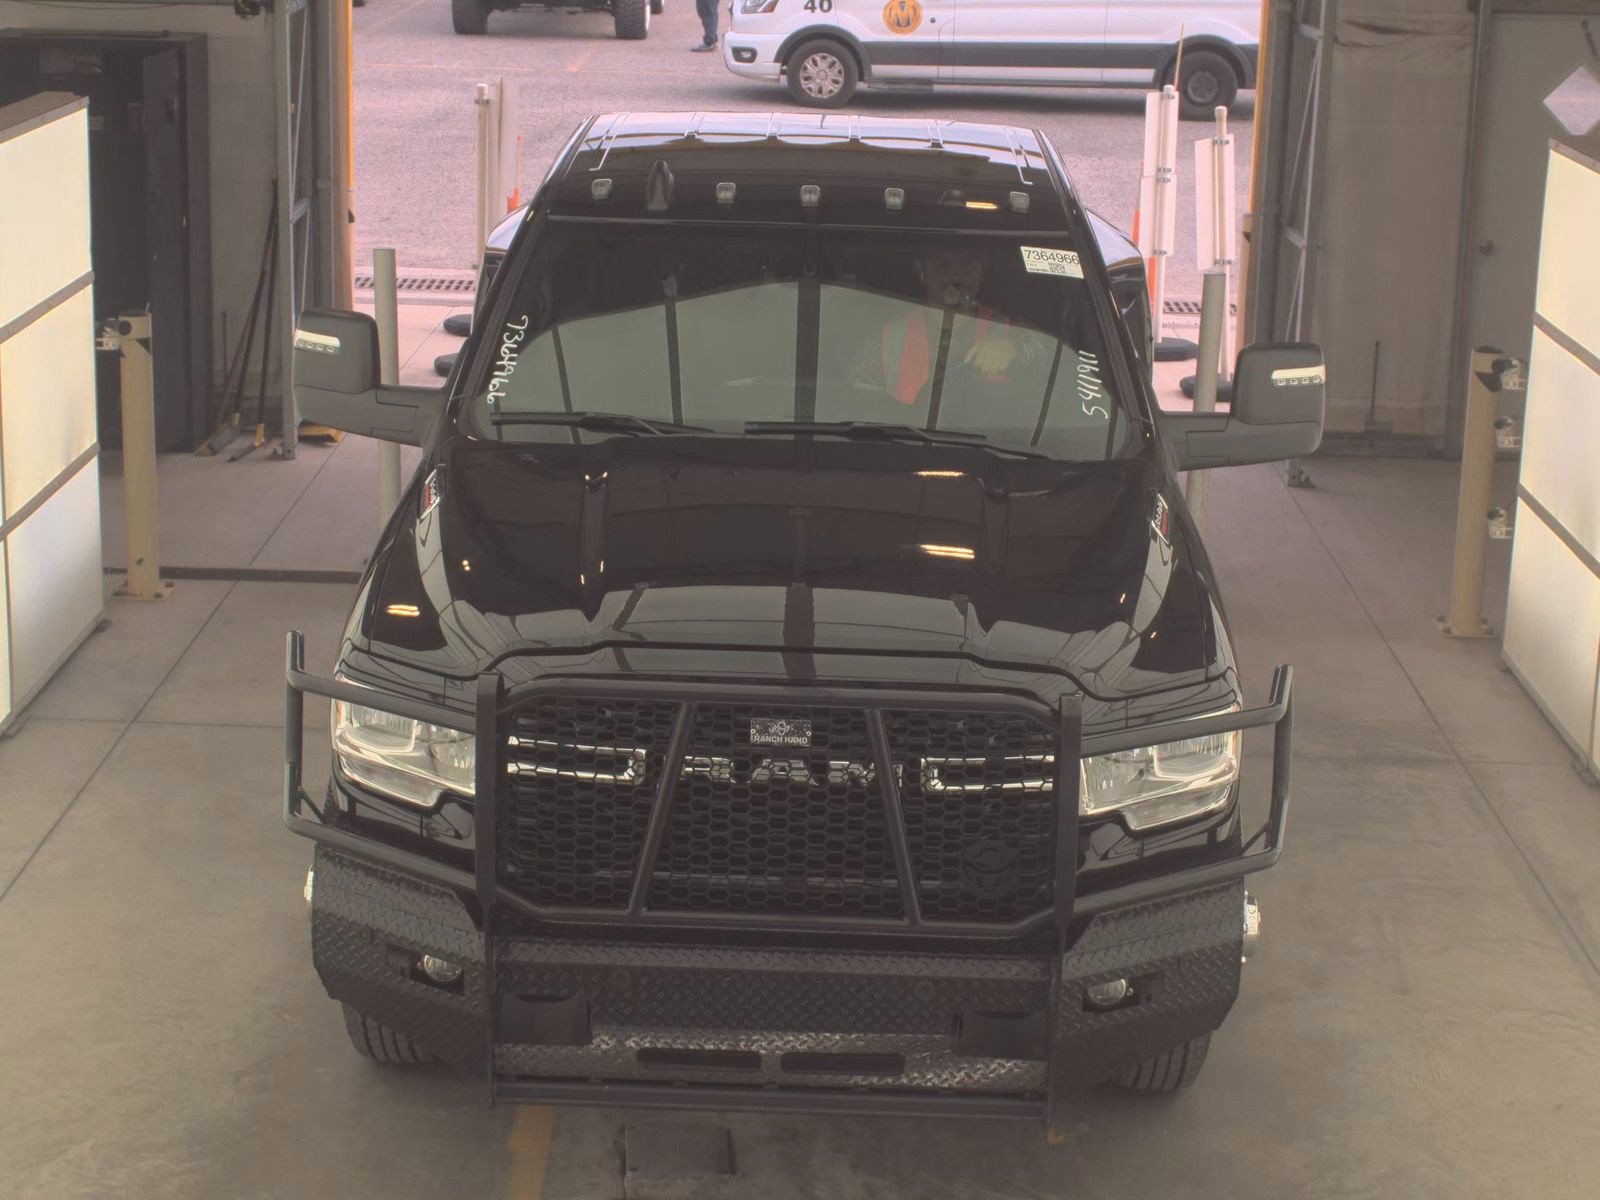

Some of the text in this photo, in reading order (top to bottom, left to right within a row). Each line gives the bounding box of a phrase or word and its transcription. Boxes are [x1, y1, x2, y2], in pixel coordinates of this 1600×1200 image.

[803, 0, 833, 13] 40
[1023, 249, 1081, 265] 7364966
[486, 314, 529, 405] 7364966
[753, 735, 808, 745] RANCH HAND
